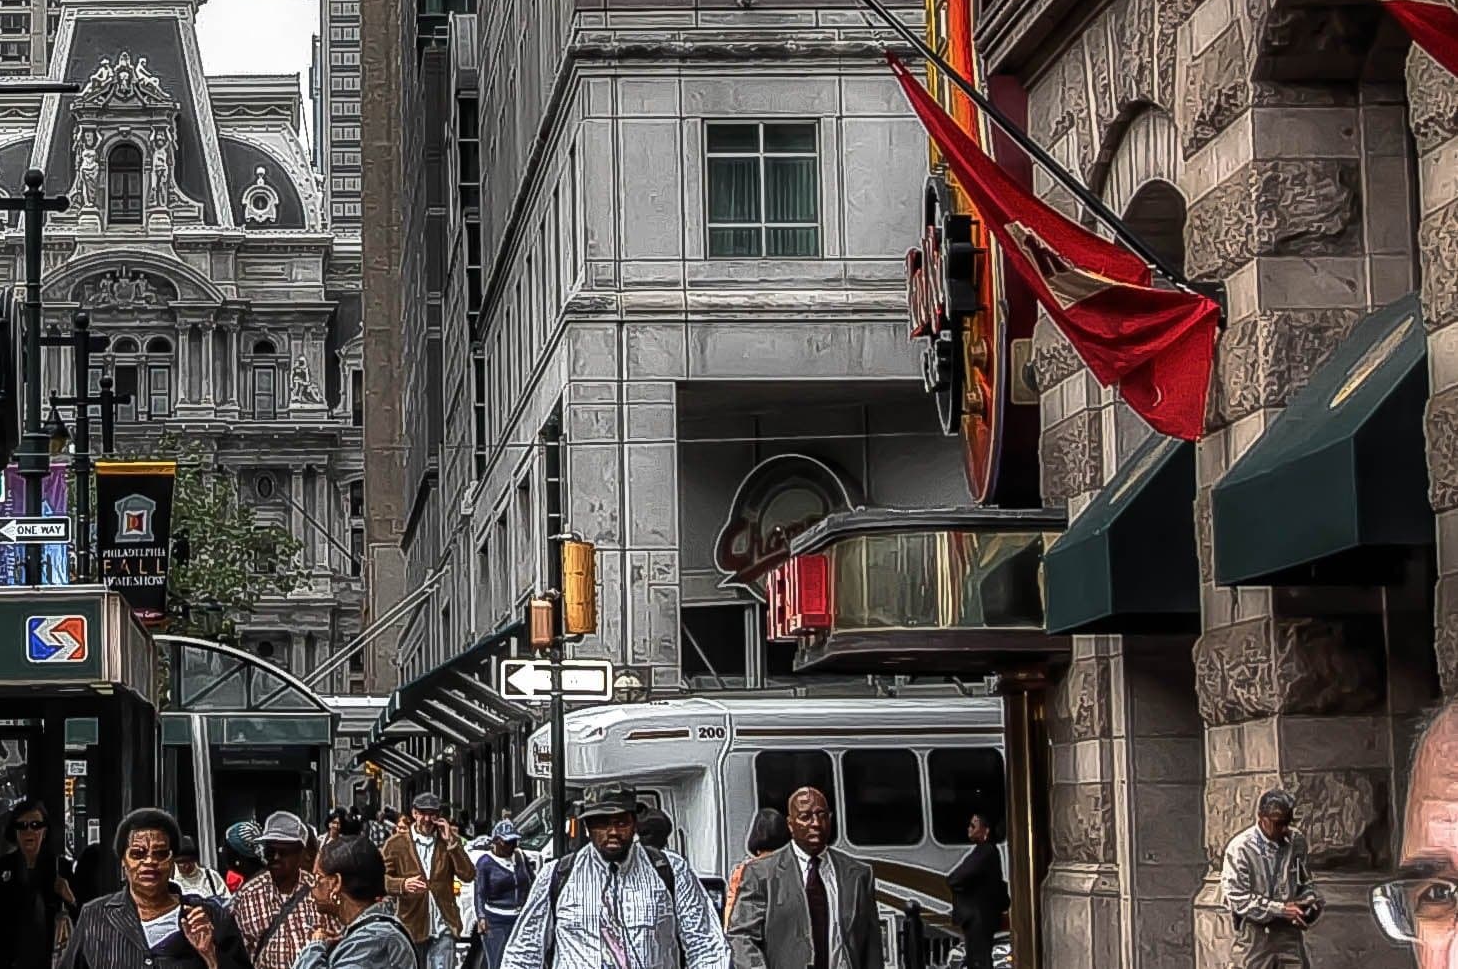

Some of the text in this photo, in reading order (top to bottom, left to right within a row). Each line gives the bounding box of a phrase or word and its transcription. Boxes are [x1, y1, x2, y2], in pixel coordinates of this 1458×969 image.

[17, 525, 62, 535] ONE WAY
[103, 558, 165, 575] FALL
[698, 726, 726, 739] 200
